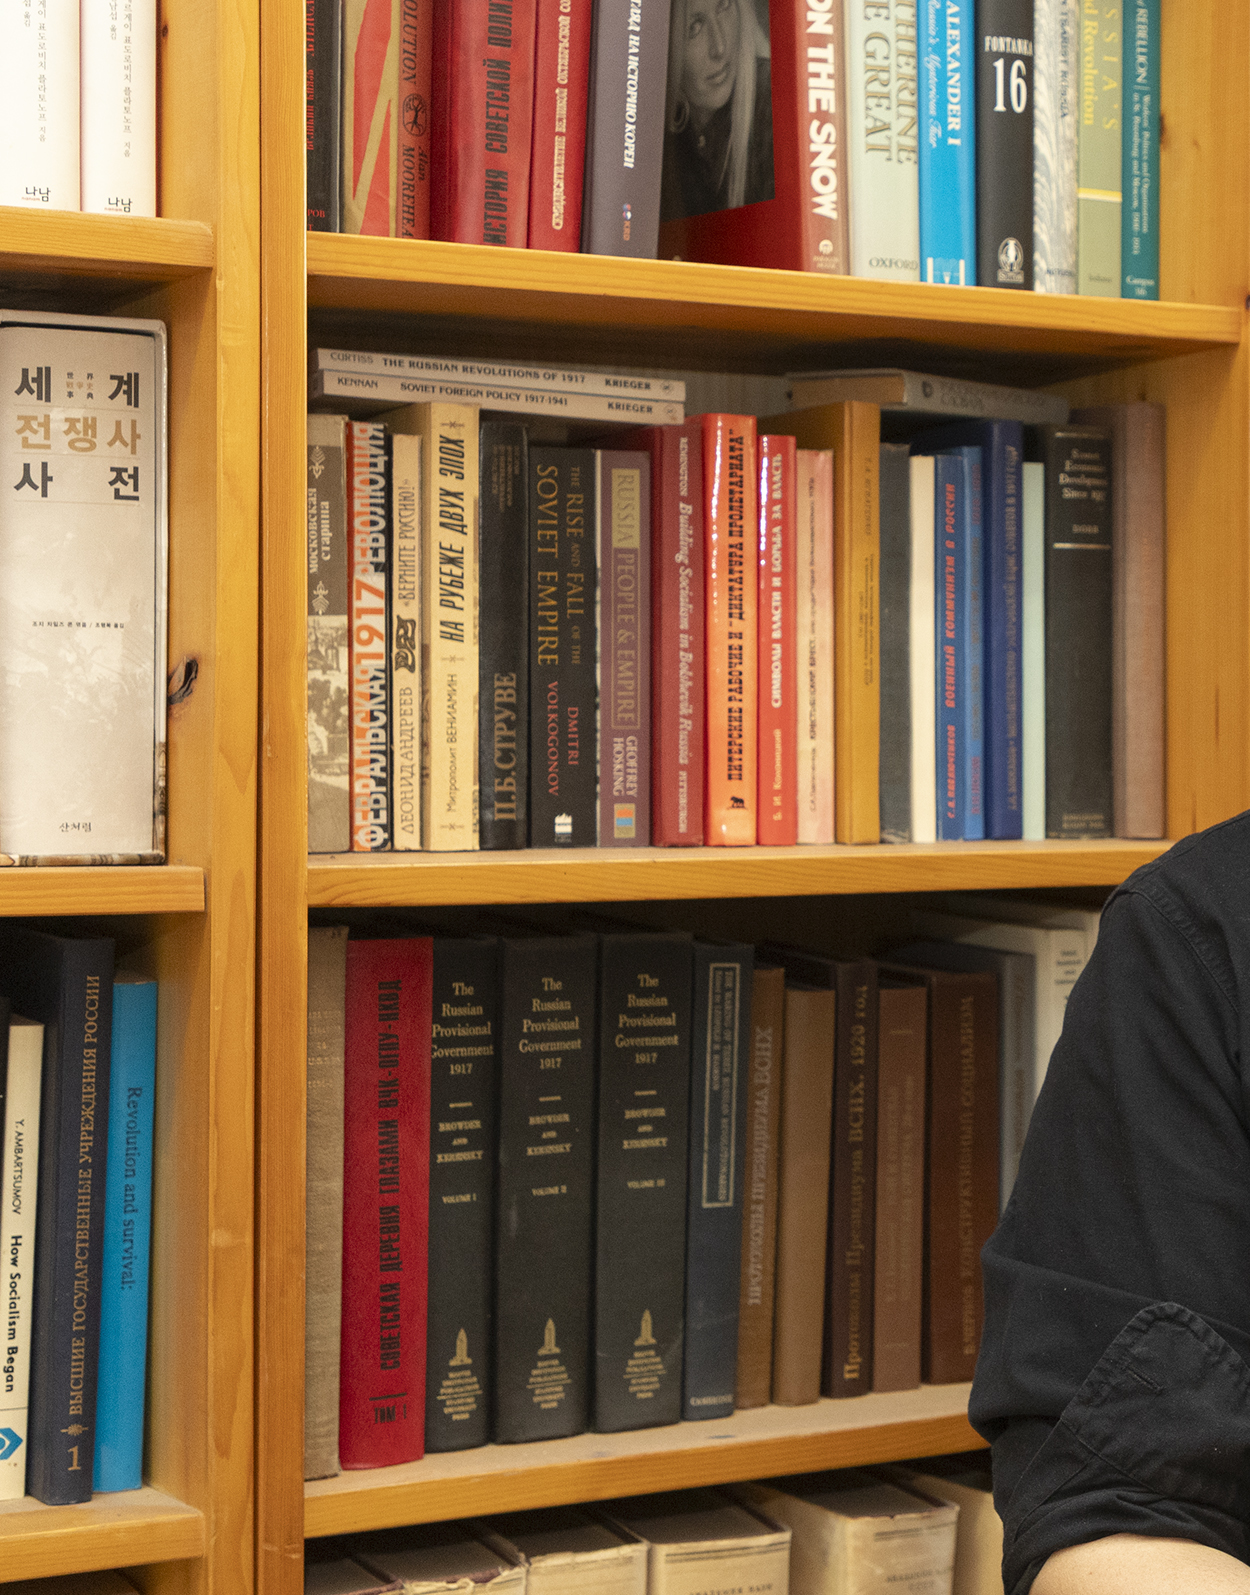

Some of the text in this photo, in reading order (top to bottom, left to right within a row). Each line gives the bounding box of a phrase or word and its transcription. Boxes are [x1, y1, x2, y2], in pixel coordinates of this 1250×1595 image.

[984, 35, 1034, 57] FONTANKA
[1135, 8, 1149, 84] REBELLION
[554, 15, 571, 134] ВЕЛИКОЙ ОКТЯБРЬСКОЙ
[946, 0, 962, 146] ALEXANDER I
[992, 57, 1028, 114] 16
[1083, 19, 1100, 126] Revolution
[623, 35, 641, 169] НА ИСТОРИЮ КОРЕИ
[806, 0, 838, 220] ON THE SNOW
[864, 32, 891, 161] GREAT
[923, 47, 943, 149] Mysterious Tsar
[37, 126, 46, 142] 지음
[123, 141, 132, 158] 지음
[483, 58, 512, 245] ИСТОРИЯ СОВЕТСКОЙ
[418, 146, 429, 182] Alan
[25, 186, 51, 202] 나남
[108, 197, 132, 213] 나남
[869, 256, 919, 271] OXFORD
[14, 366, 140, 408] 세 계
[330, 351, 651, 391] CURTISS THE RUSSIAN REVOLUTIONS OF 1917 KRIEGER
[337, 376, 653, 414] KENNAN SOVIET FOREIGN POLICY 1917-1941 KRIEGER
[15, 414, 141, 456] 전쟁사
[14, 461, 140, 501] 사 전
[679, 436, 689, 497] REMINGTON
[319, 501, 332, 560] старина
[675, 502, 694, 564] Building
[537, 464, 559, 666] SOVIET EMPIRE
[566, 466, 585, 665] THE RISE AND FALL OF THE
[616, 474, 636, 722] RUSSIA PEOPLE & EMPIRE
[679, 565, 694, 631] Socialism
[943, 483, 956, 709] ВОЕННЫЙ КОММУНИЗМ В РОССИИ
[353, 422, 389, 848] ФЕВРАЛЬСКАЯ 1917 РЕВОЛЮЦИЯ
[439, 434, 468, 812] Митрополит ВЕНИАМИН НА РУБЕЖЕ ДВУХ ЭПОХ
[679, 633, 694, 649] in
[771, 453, 783, 790] Колоницкий СИМВОЛЫ ВЛАСТИ И БОРЬБА ЗА ВЛАСТЬ
[679, 651, 694, 716] Bolshevik
[727, 631, 744, 781] ПИТЕРСКИЕ РАБОЧИЕ И
[547, 681, 560, 796] VOLKOGONOV
[567, 706, 580, 766] DMITRI
[678, 718, 694, 765] Russia
[398, 686, 415, 835] ЛЕОНИД АНДРЕЕВ
[612, 736, 625, 796] HOSKING
[625, 735, 638, 798] GEOFFREY
[59, 822, 92, 833] 산처럼
[452, 982, 475, 997] The
[541, 978, 563, 991] The
[627, 995, 668, 1008] Russian
[637, 974, 659, 988] The
[441, 1003, 483, 1017] Russian
[522, 1016, 580, 1033] Provisional
[531, 999, 571, 1012] Russian
[618, 1012, 676, 1028] Provisional
[430, 1043, 494, 1058] Government
[432, 1022, 492, 1039] Provisional
[518, 1038, 582, 1053] Government
[614, 1034, 679, 1048] Government
[449, 1063, 473, 1076] 1917
[539, 1057, 562, 1070] 1917
[634, 1052, 658, 1064] 1917
[753, 1026, 773, 1085] ВСНХ
[438, 1120, 482, 1132] BROWDER
[528, 1114, 570, 1126] BROWDER
[624, 1108, 666, 1119] BROWDER
[69, 975, 100, 1415] ВЫСШИЕ ГОСУДАРСТВЕННЫЕ УЧРЕЖДЕНИЯ РОССИИ
[120, 1086, 143, 1291] Revolution and survival:
[4, 1119, 25, 1393] Y. AMBARTSUMOV How Socialism Began
[378, 1120, 403, 1370] СОВЕТСКАЯ ДЕРЕВНЯ ГЛАЗАМИ
[374, 1406, 397, 1424] ТОМ
[67, 1446, 82, 1471] 1
